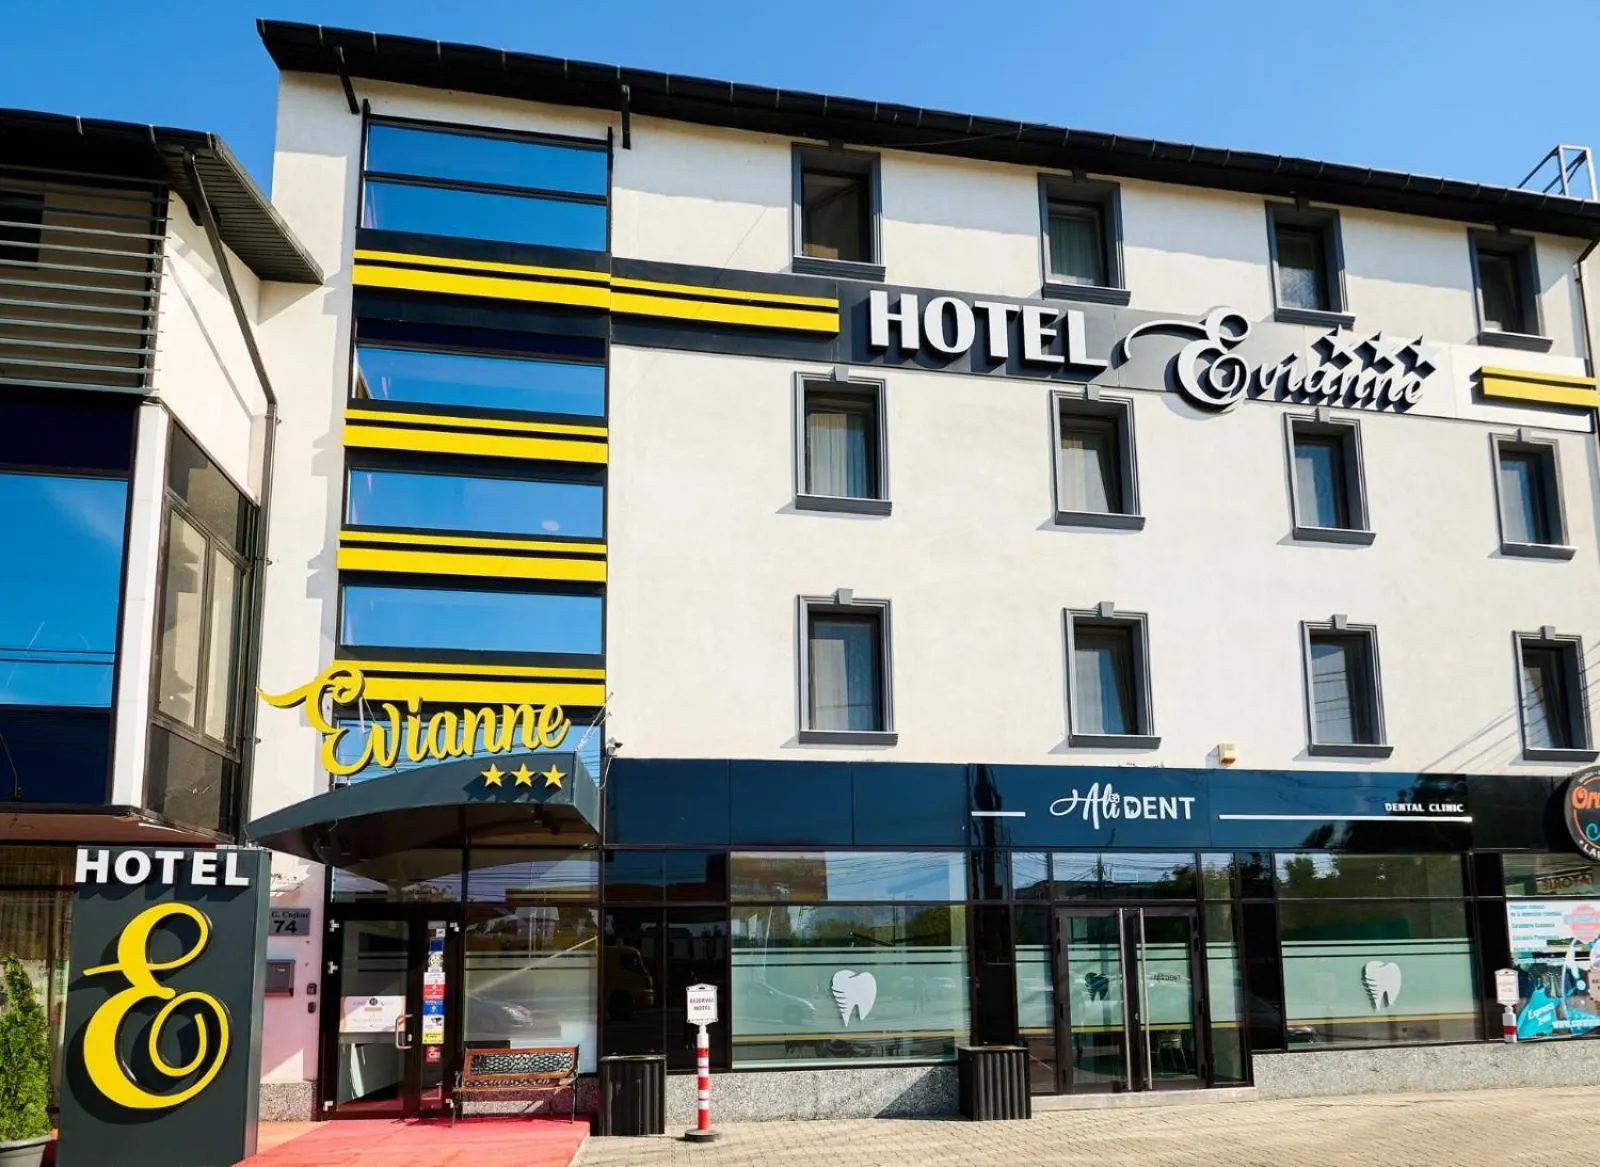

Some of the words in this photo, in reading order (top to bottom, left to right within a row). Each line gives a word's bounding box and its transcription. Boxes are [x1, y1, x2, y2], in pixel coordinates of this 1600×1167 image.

[869, 289, 1109, 367] HOTEL
[1123, 306, 1424, 405] Evianne
[256, 660, 570, 775] Evianne
[1384, 803, 1425, 812] DENTAL
[1429, 803, 1465, 813] CLINIC
[74, 848, 250, 887] HOTEL
[273, 920, 298, 934] 74
[82, 902, 230, 1109] E
